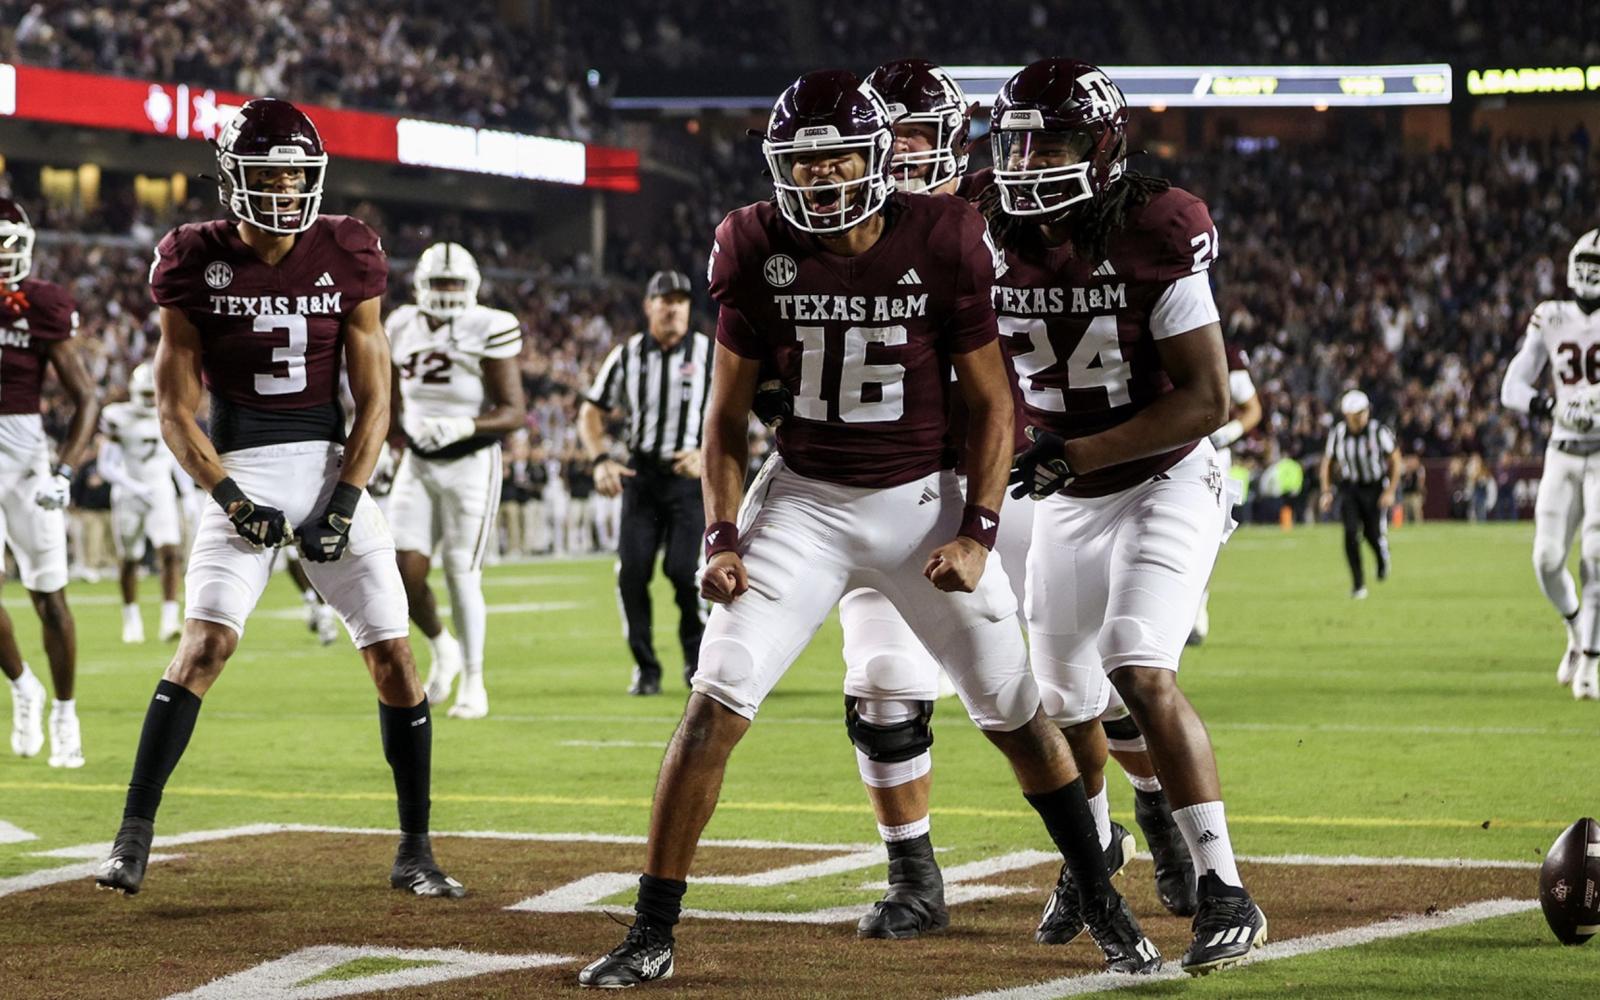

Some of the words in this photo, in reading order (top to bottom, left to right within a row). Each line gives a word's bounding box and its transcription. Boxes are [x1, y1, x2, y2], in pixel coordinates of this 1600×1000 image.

[206, 265, 232, 286] SEC
[767, 256, 794, 285] SEC
[210, 295, 289, 315] TEXAS
[296, 292, 342, 314] A&M
[774, 295, 867, 321] TEXAS
[872, 293, 928, 322] A&M
[990, 285, 1064, 313] TEXAS
[1071, 283, 1127, 312] A&M
[253, 314, 308, 395] 3
[997, 315, 1132, 412] 24
[793, 325, 908, 423] 16
[641, 948, 671, 979] Aggies
